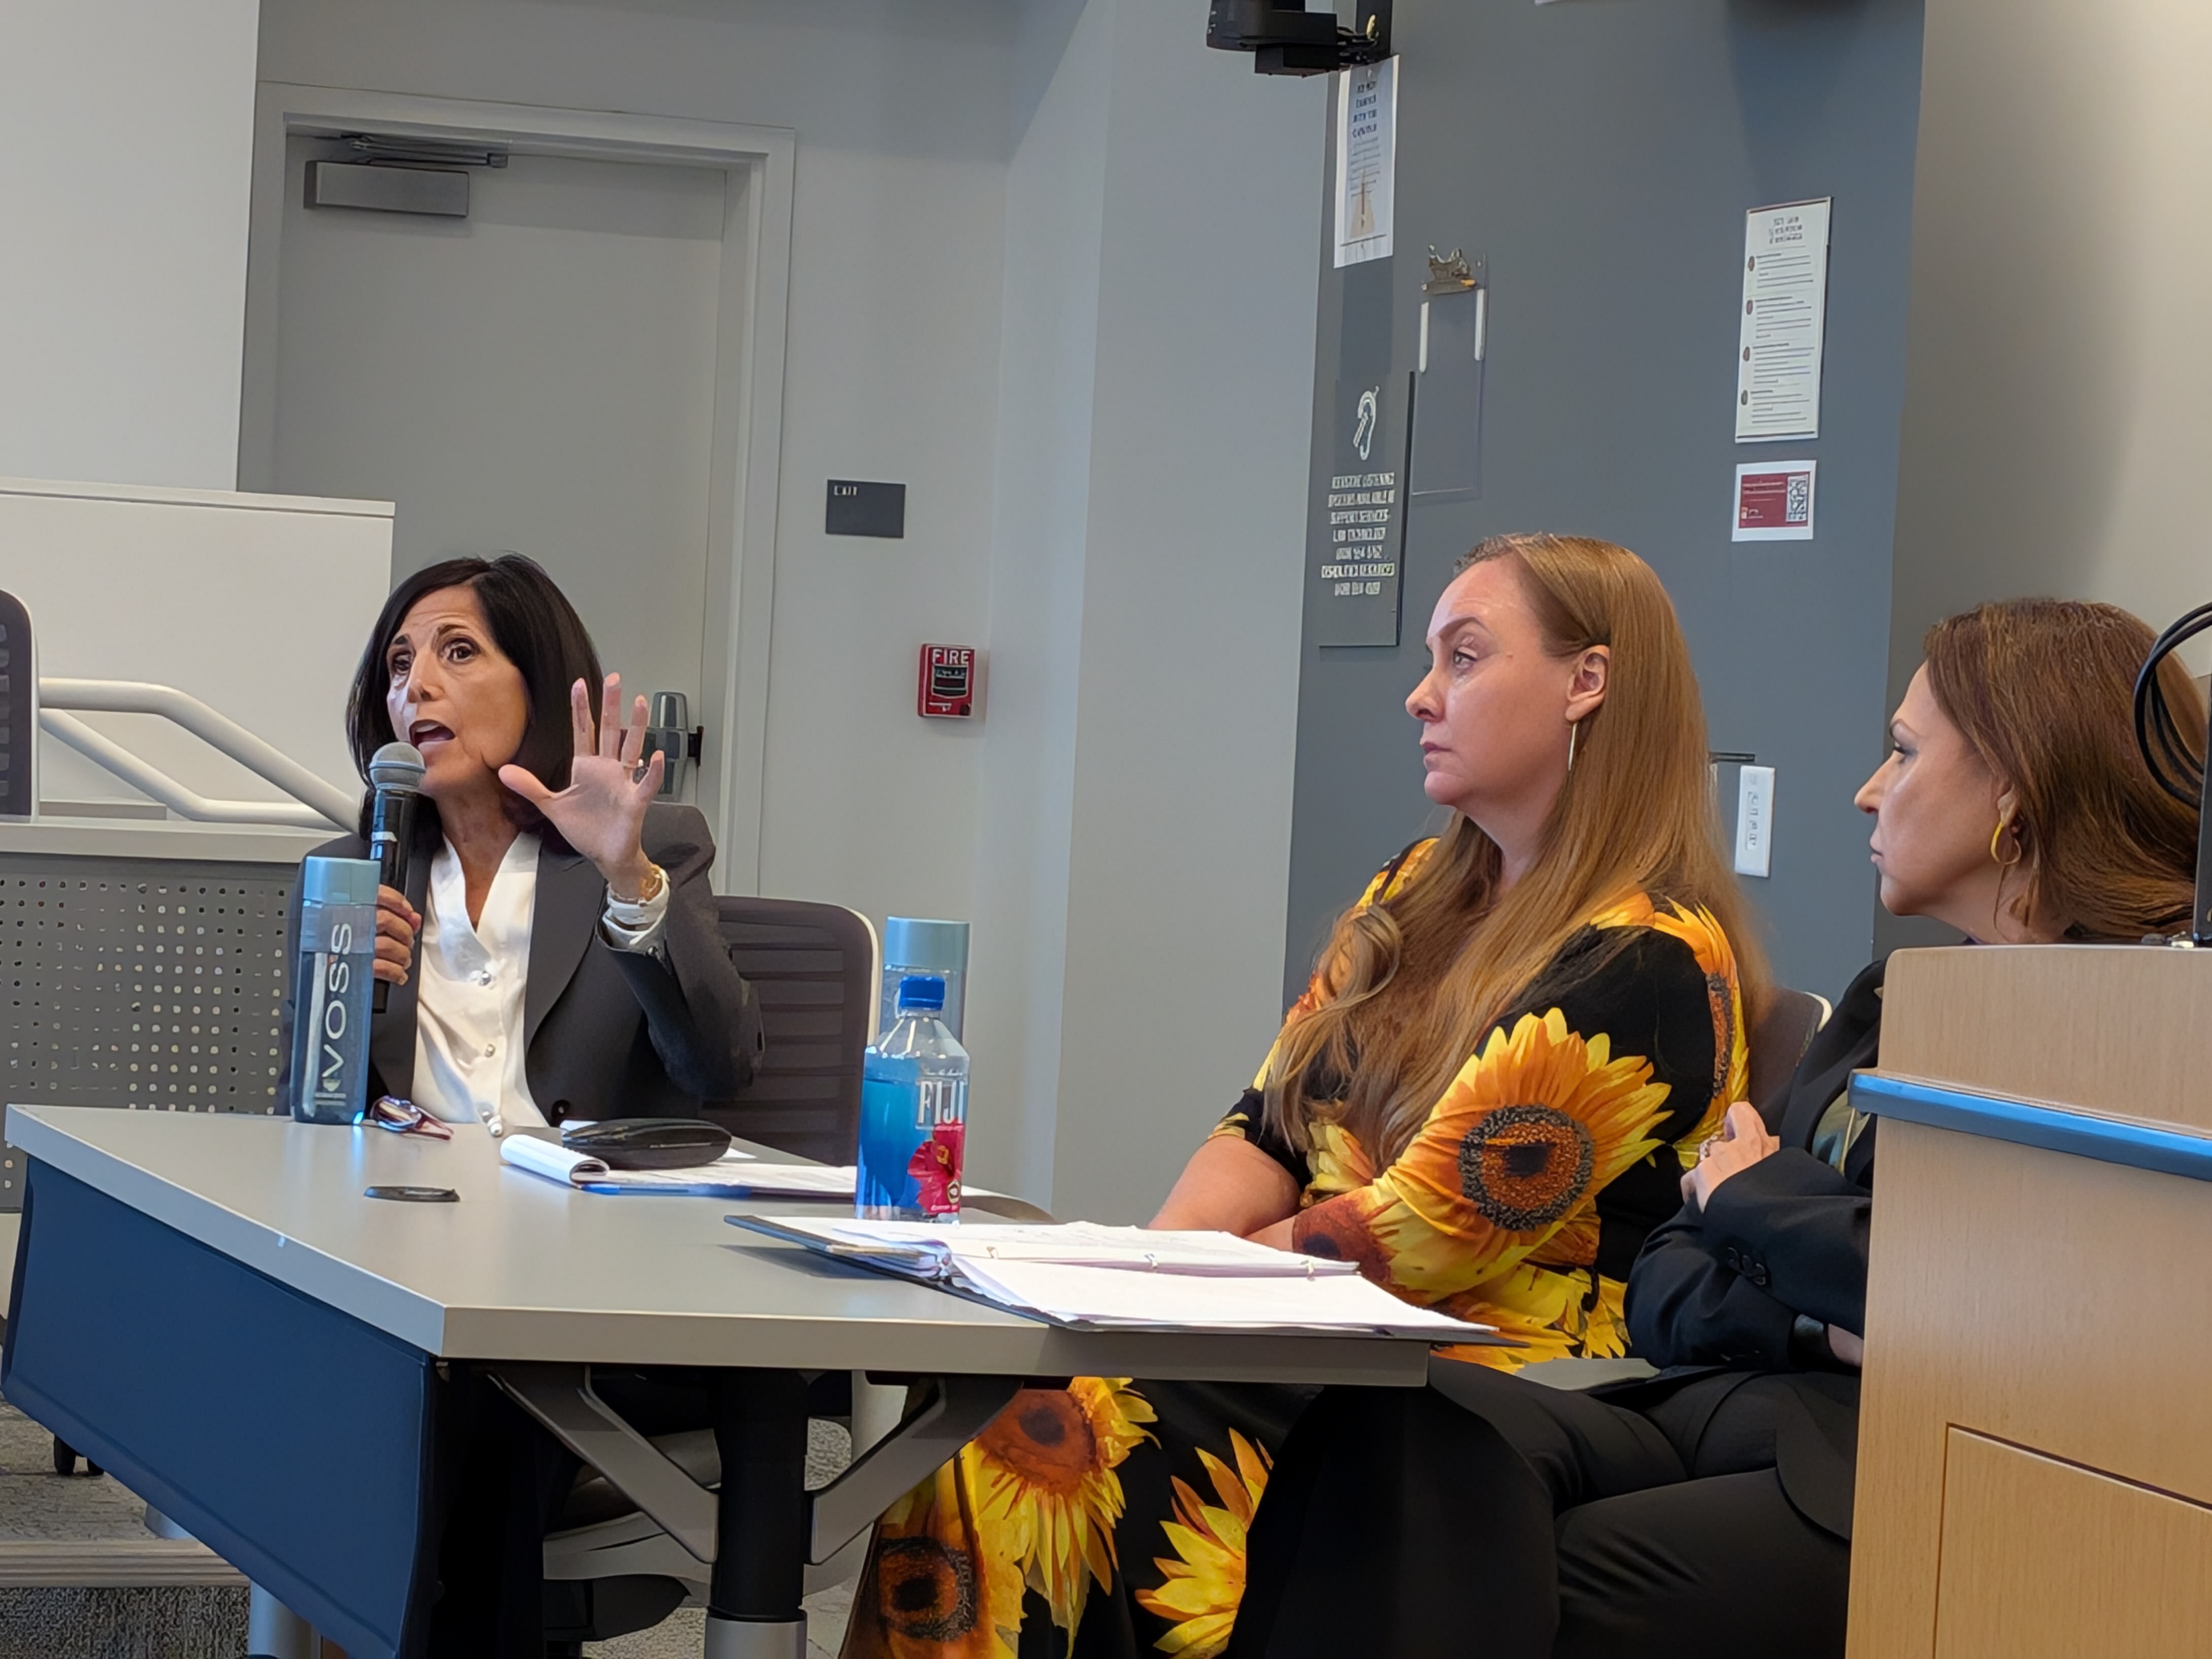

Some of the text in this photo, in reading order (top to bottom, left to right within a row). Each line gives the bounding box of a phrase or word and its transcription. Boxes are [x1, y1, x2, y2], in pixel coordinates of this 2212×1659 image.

[932, 649, 971, 665] FIRE
[321, 922, 352, 1078] VOSS
[917, 1080, 965, 1125] FIJI
